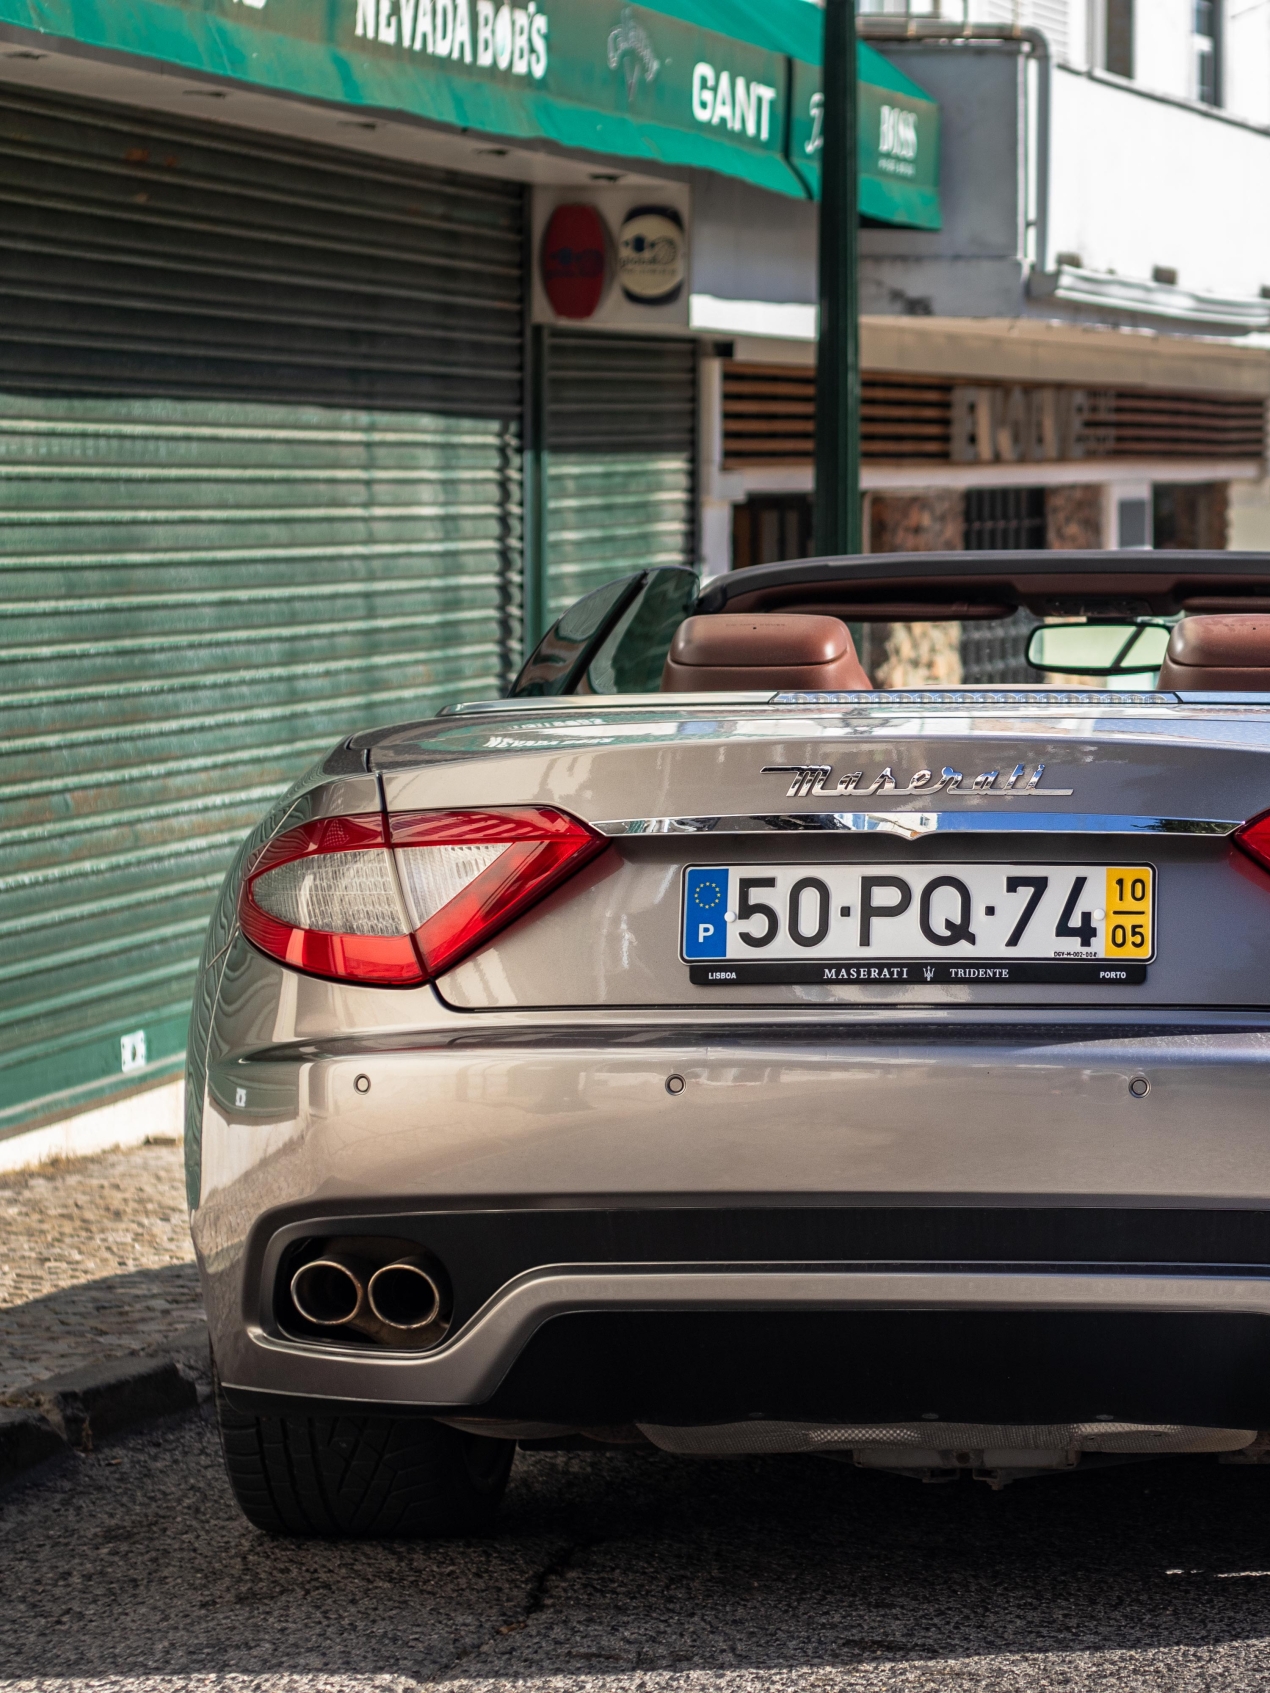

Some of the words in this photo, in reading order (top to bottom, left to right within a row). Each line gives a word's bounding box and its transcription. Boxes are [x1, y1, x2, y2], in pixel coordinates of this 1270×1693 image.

[476, 0, 548, 80] BOB'S
[692, 62, 777, 142] GANT
[759, 763, 1074, 797] Maserati
[1114, 877, 1147, 902] 10
[697, 924, 715, 943] P
[1112, 923, 1146, 949] 05
[707, 972, 737, 980] LISBOA
[822, 967, 909, 979] MASERATI
[949, 967, 1010, 979] TRIDENTE
[1099, 971, 1127, 979] PORTO
